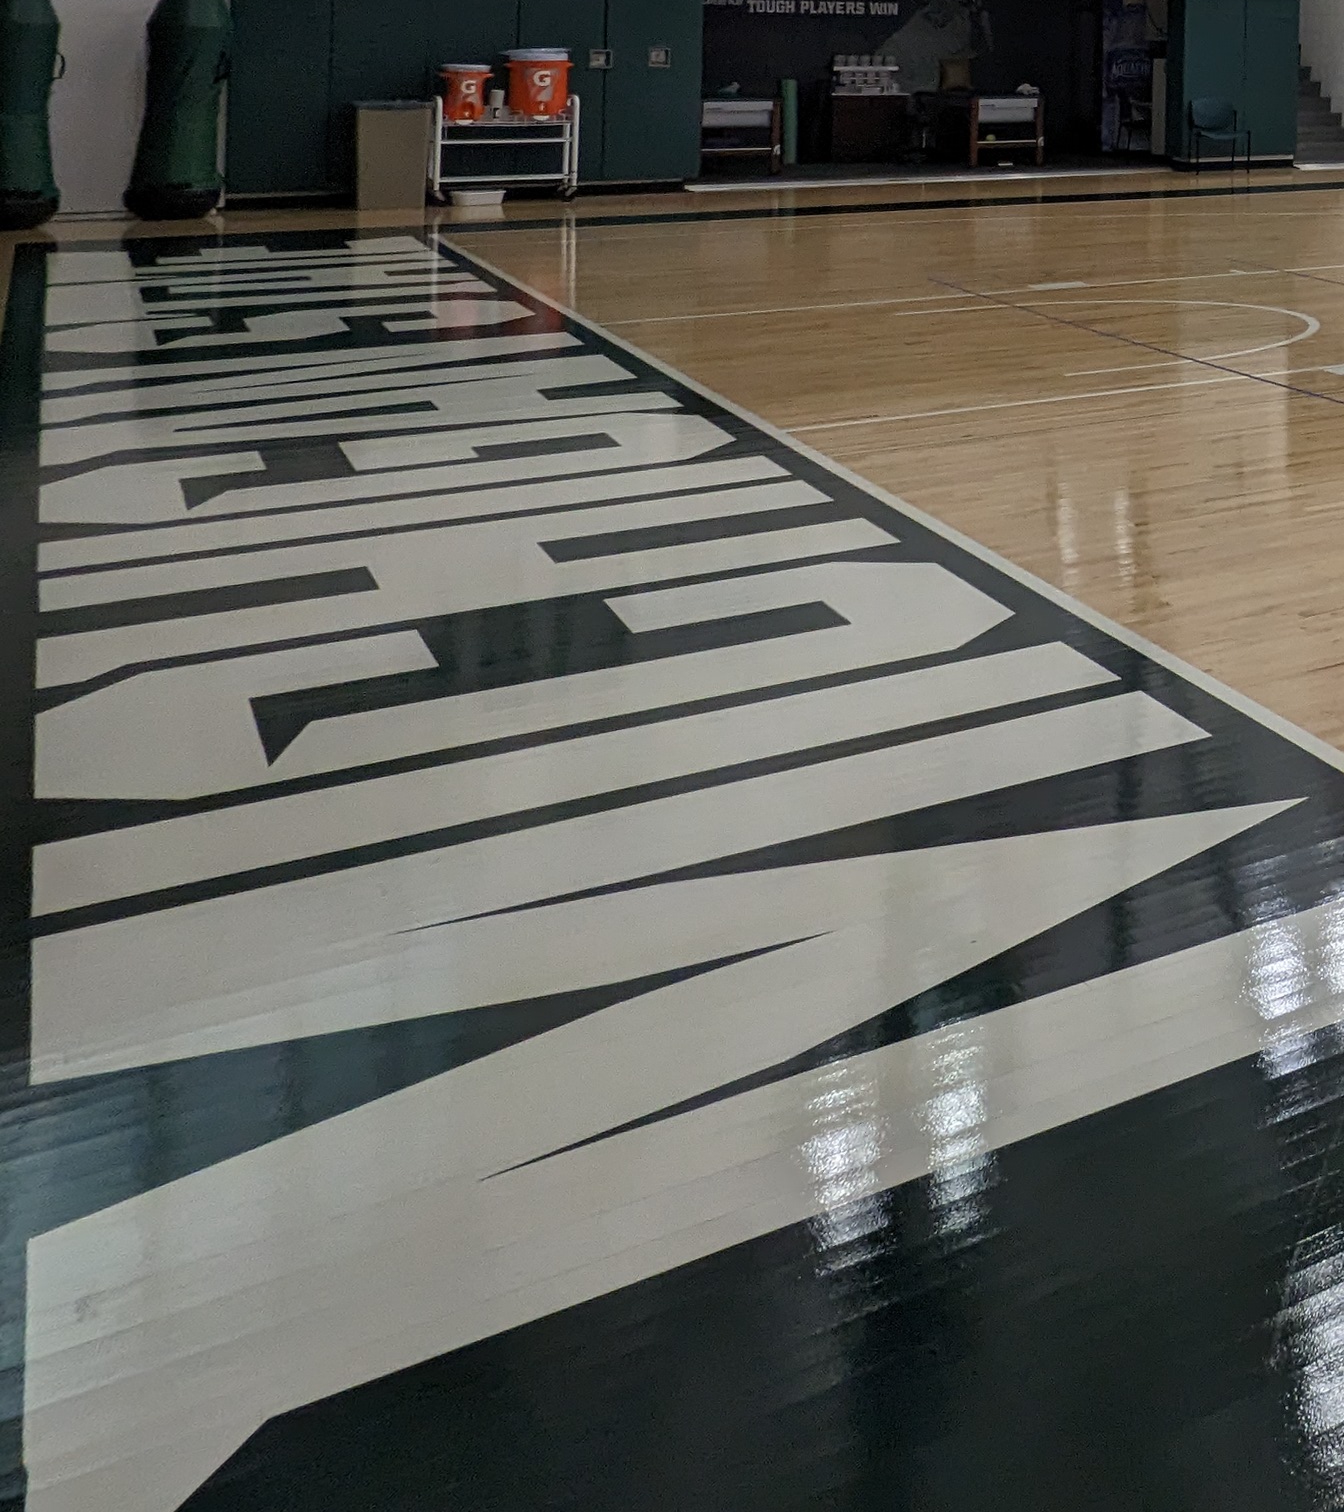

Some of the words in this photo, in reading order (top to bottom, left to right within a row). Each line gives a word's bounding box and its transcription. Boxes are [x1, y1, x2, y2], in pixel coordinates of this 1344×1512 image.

[747, 0, 795, 14] TOUGH
[800, 0, 865, 15] PLAYERS
[869, 2, 899, 16] WIN
[533, 70, 551, 87] G
[460, 80, 477, 94] G
